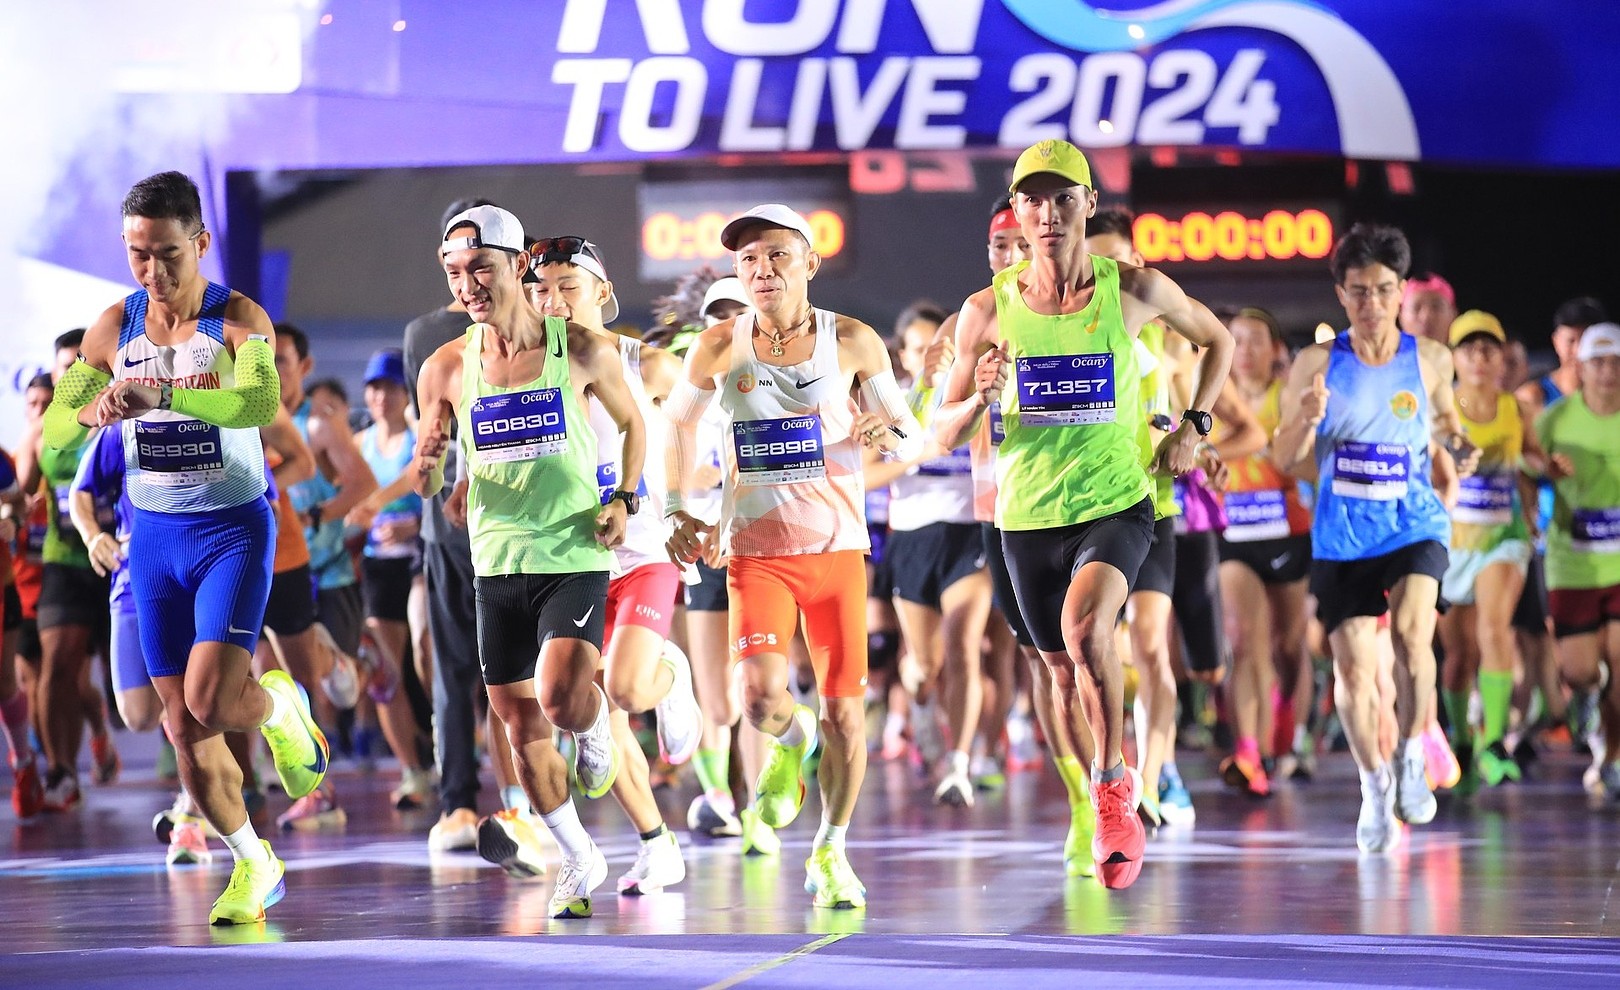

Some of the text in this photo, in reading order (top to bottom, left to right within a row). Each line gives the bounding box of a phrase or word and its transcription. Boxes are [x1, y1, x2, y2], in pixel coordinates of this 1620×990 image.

[551, 49, 1281, 153] TO LIVE 2024
[1132, 209, 1333, 262] 0:00:00
[1071, 357, 1108, 368] Ocany
[758, 379, 773, 387] NN
[1023, 378, 1108, 396] 71357
[521, 391, 556, 404] Ocany
[177, 422, 212, 433] Ocany
[478, 412, 559, 435] 60830
[781, 419, 816, 430] Ocany
[140, 441, 216, 457] 82930
[740, 439, 818, 457] 82898
